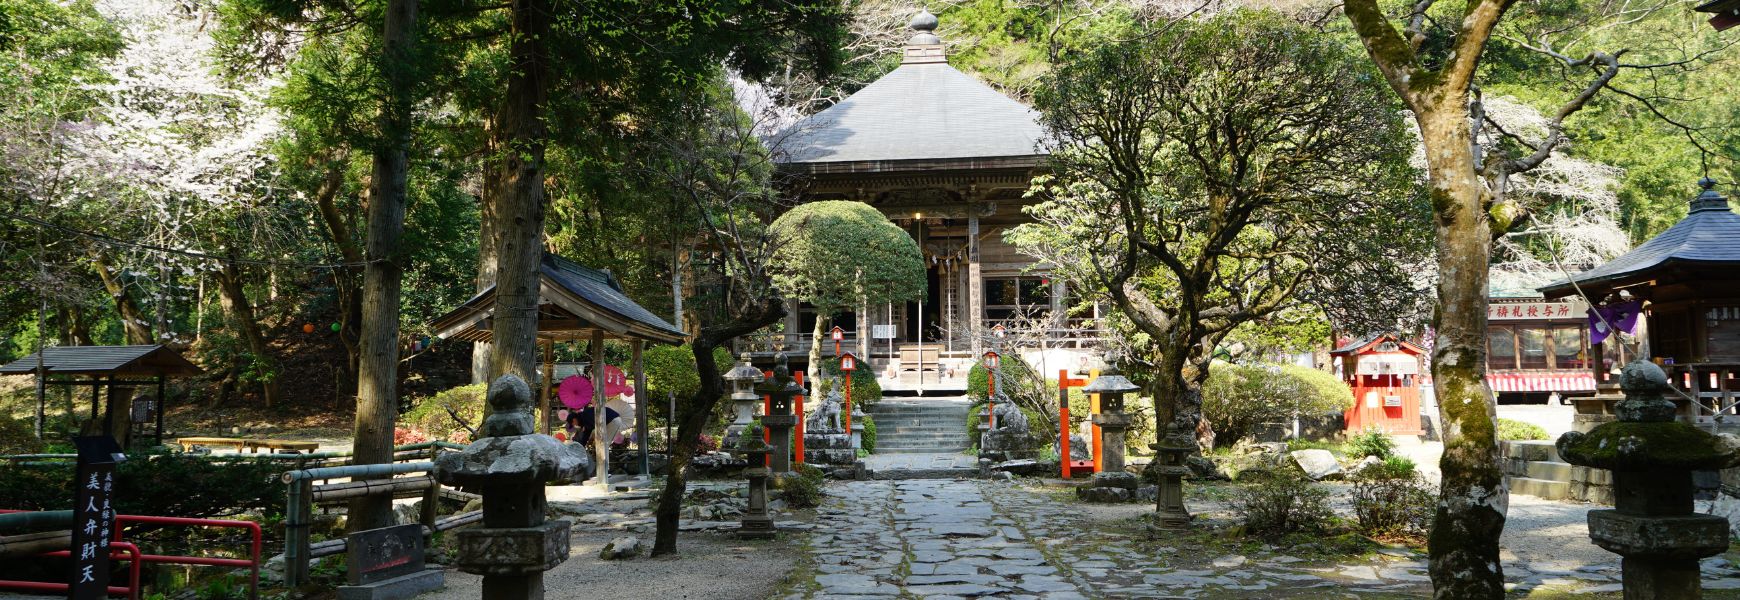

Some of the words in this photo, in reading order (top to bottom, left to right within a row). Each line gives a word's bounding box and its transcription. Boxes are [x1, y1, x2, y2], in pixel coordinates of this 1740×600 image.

[80, 471, 100, 583] 美人弁財天
